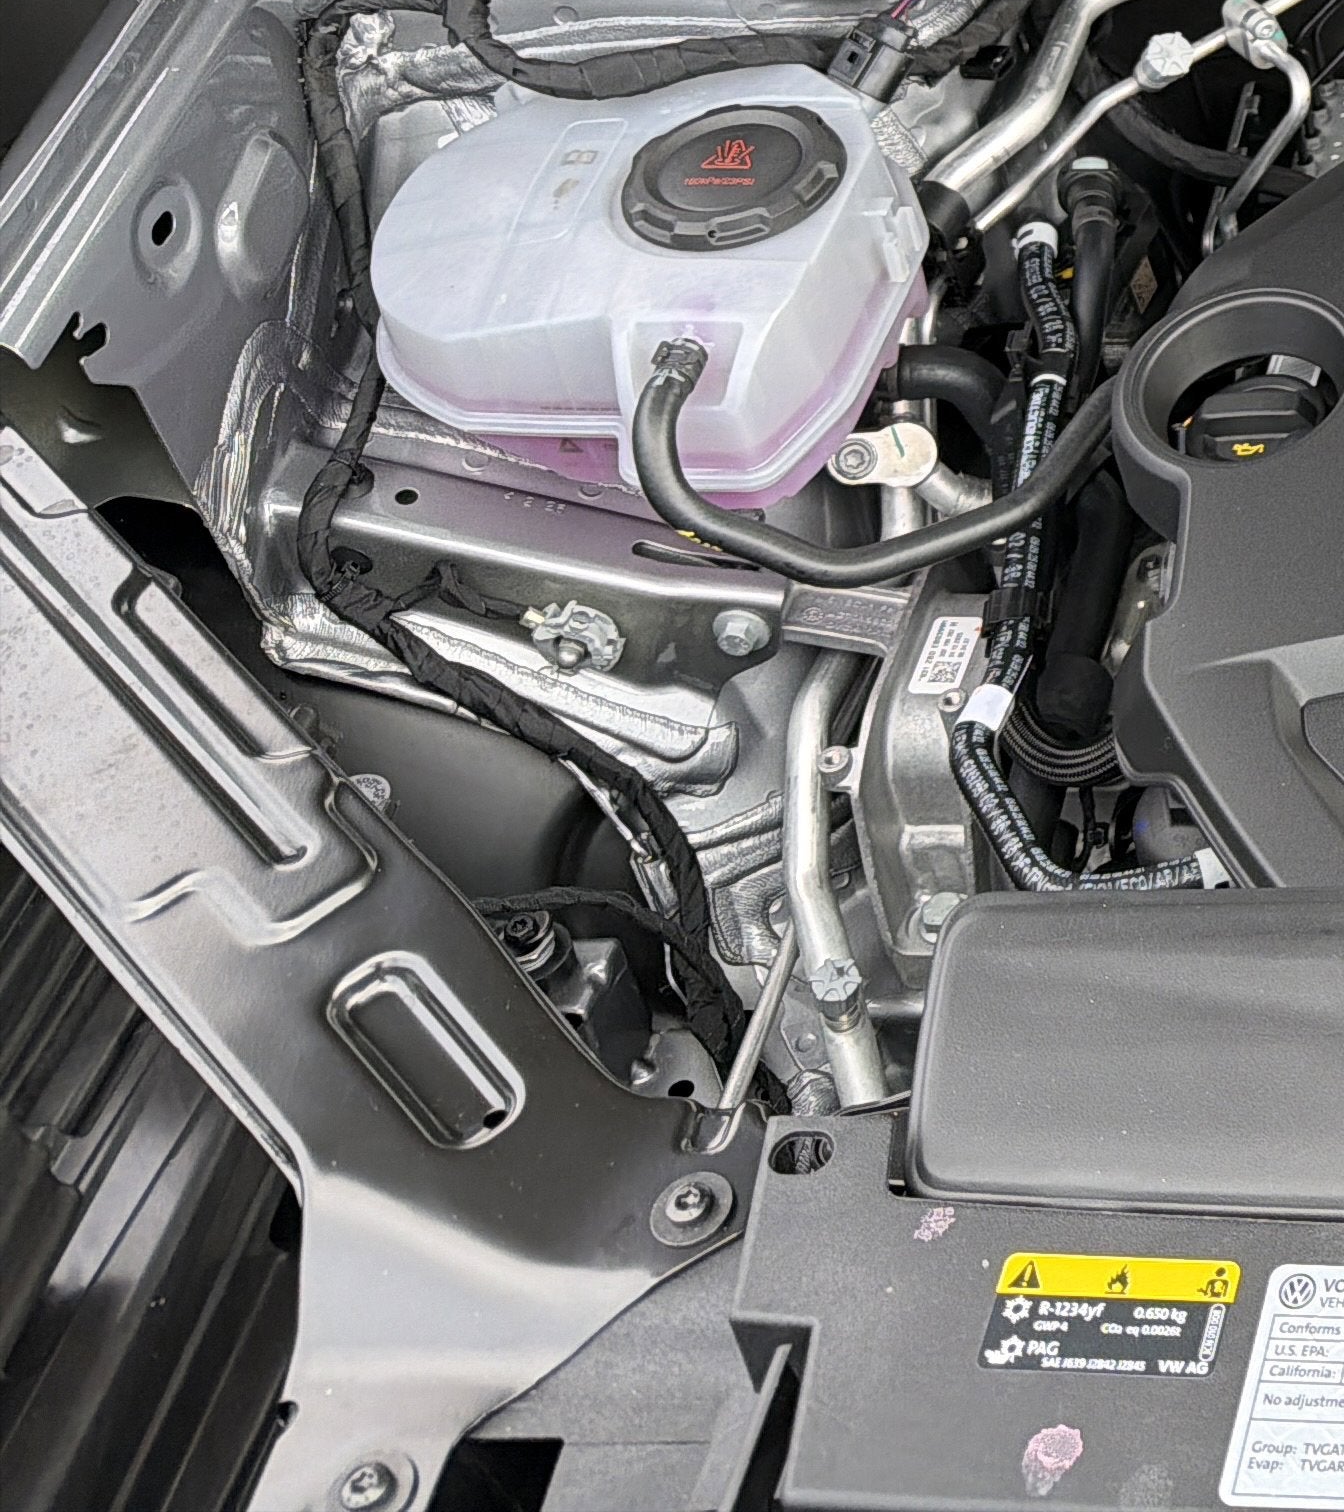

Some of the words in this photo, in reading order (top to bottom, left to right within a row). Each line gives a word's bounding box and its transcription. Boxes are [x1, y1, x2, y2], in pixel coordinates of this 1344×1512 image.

[1038, 1300, 1106, 1321] R-1234yf
[1170, 1307, 1187, 1324] kg
[1278, 1321, 1340, 1335] Conforms
[1026, 1340, 1059, 1355] PAG
[1300, 1344, 1329, 1357] EPA:
[1158, 1359, 1185, 1373] VW
[1184, 1360, 1208, 1374] AG
[1268, 1364, 1336, 1378] California:
[1262, 1393, 1282, 1405] No
[1251, 1440, 1297, 1456] Group:
[1247, 1456, 1283, 1472] Evap:
